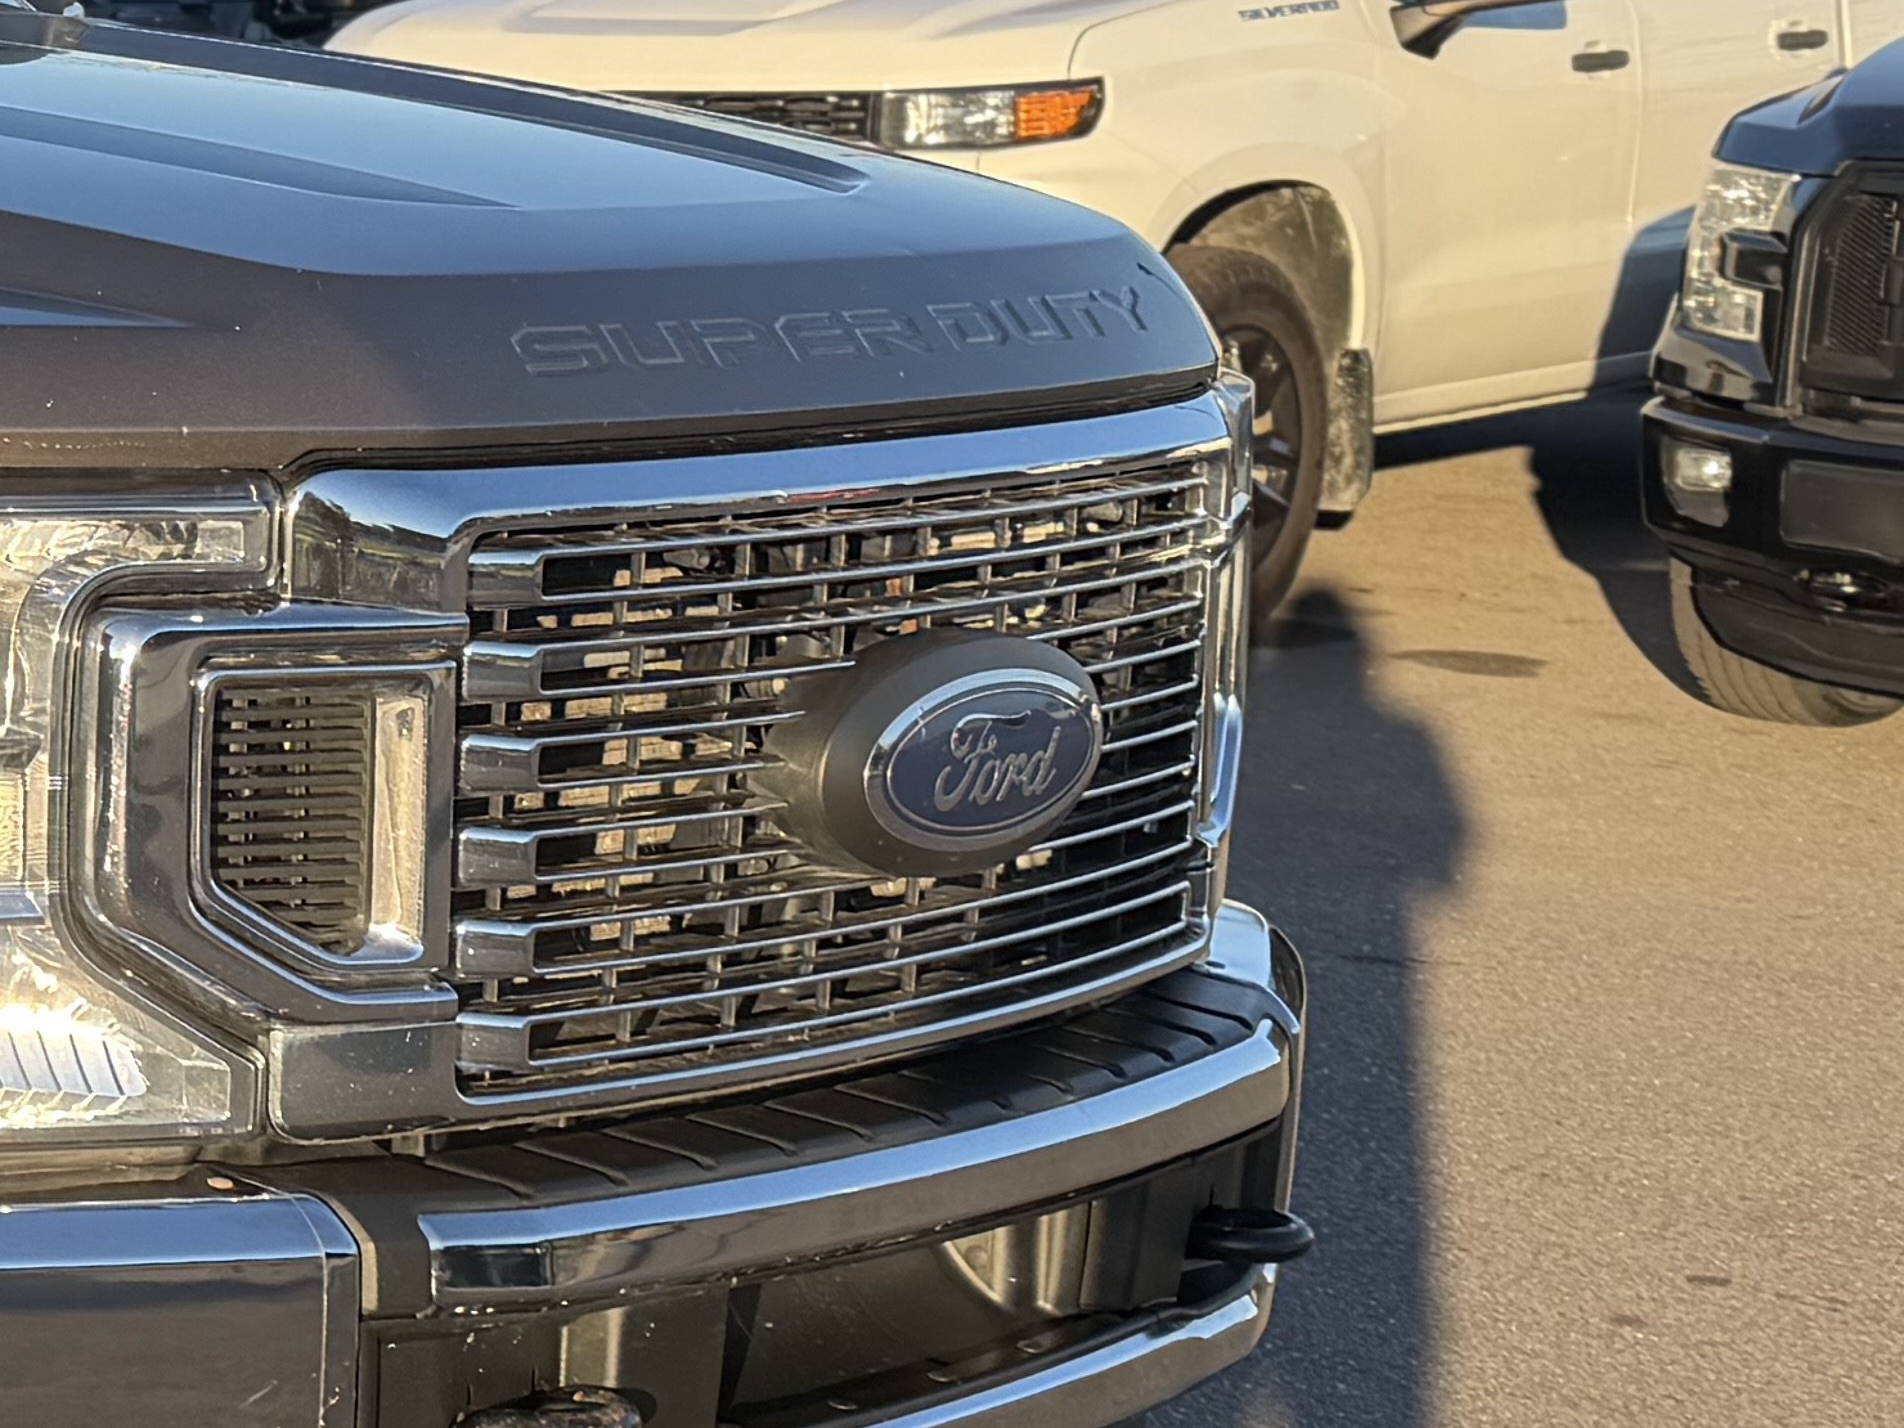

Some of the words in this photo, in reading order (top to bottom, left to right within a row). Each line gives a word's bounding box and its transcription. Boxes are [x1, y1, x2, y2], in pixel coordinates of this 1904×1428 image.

[510, 308, 934, 376] SUPER
[926, 285, 1149, 353] DUTY
[934, 712, 1062, 812] Ford
